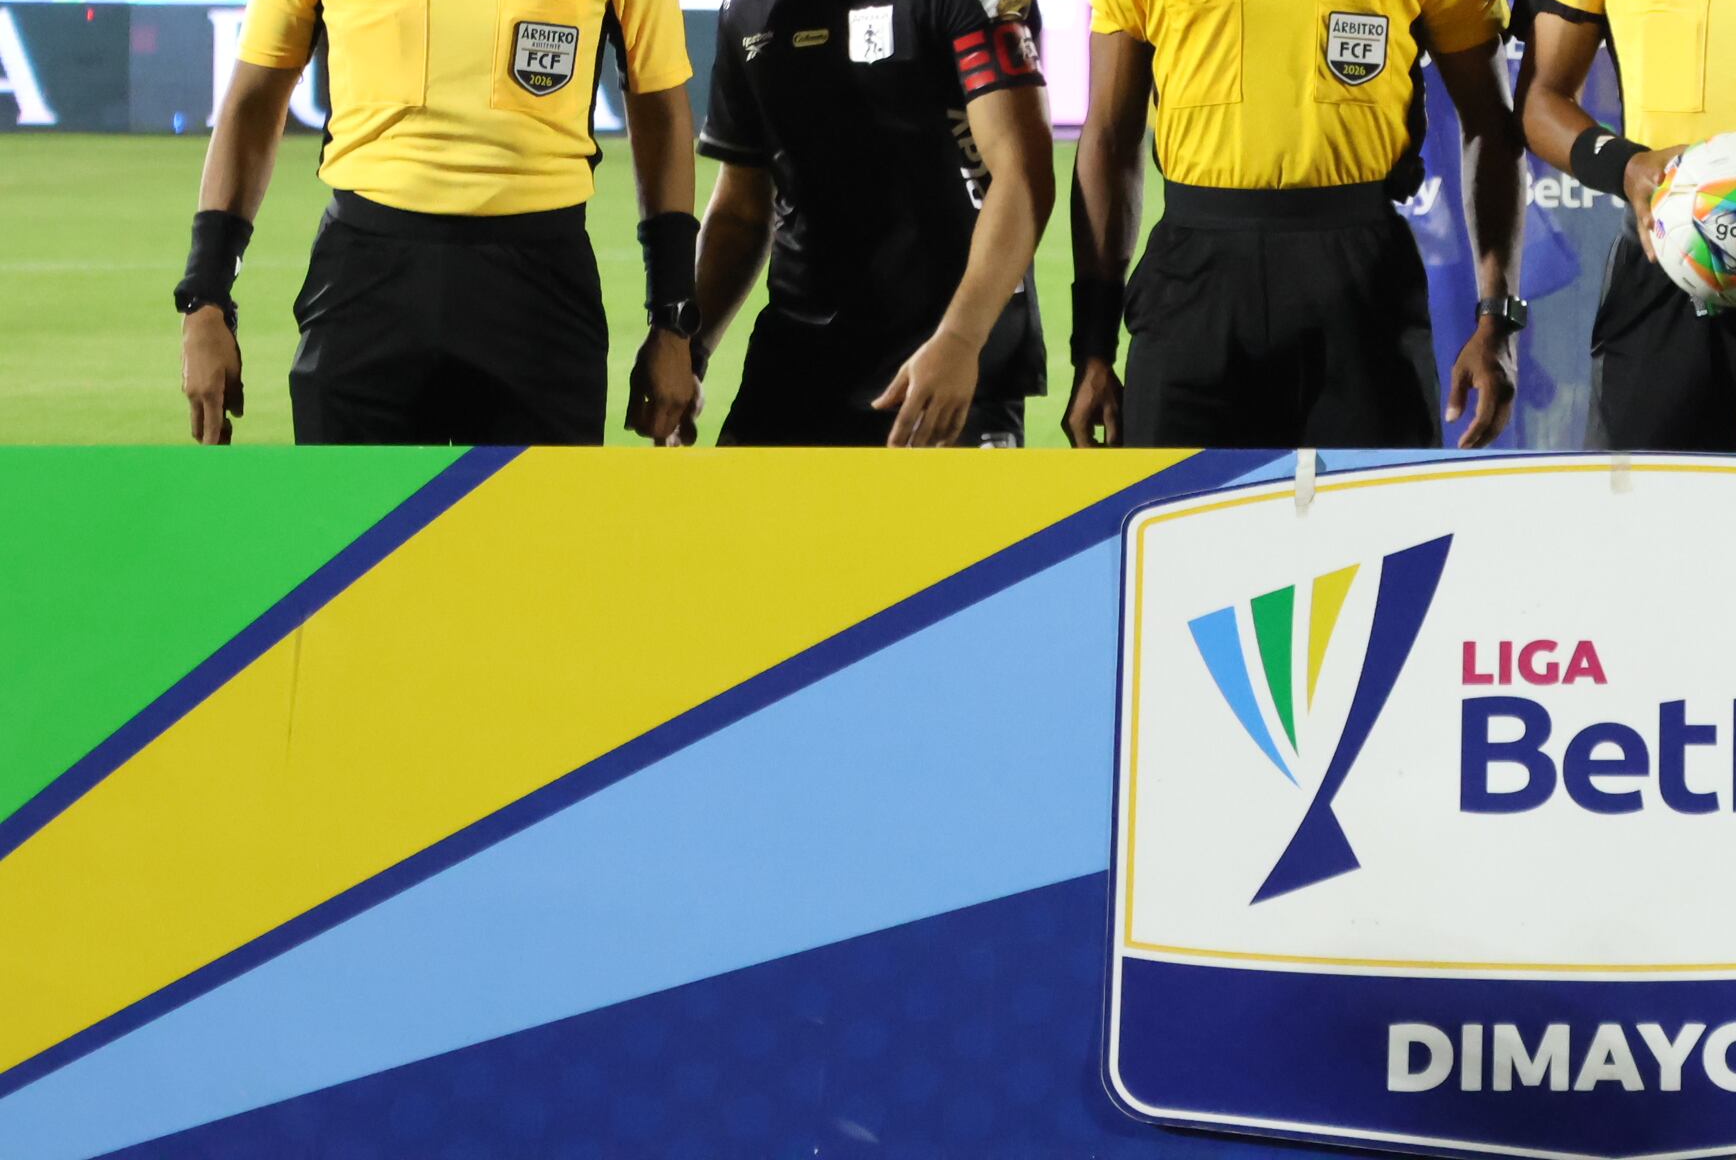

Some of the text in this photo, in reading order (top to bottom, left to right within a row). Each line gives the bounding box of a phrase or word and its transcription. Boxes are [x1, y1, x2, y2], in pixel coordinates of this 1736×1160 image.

[521, 24, 575, 45] ÁRBITRO
[1332, 18, 1384, 36] ÁRBITRO
[526, 50, 561, 70] FCF
[1339, 41, 1373, 60] FCF
[1342, 63, 1367, 76] 2026
[529, 74, 554, 87] 2026
[1460, 639, 1608, 686] LIGA
